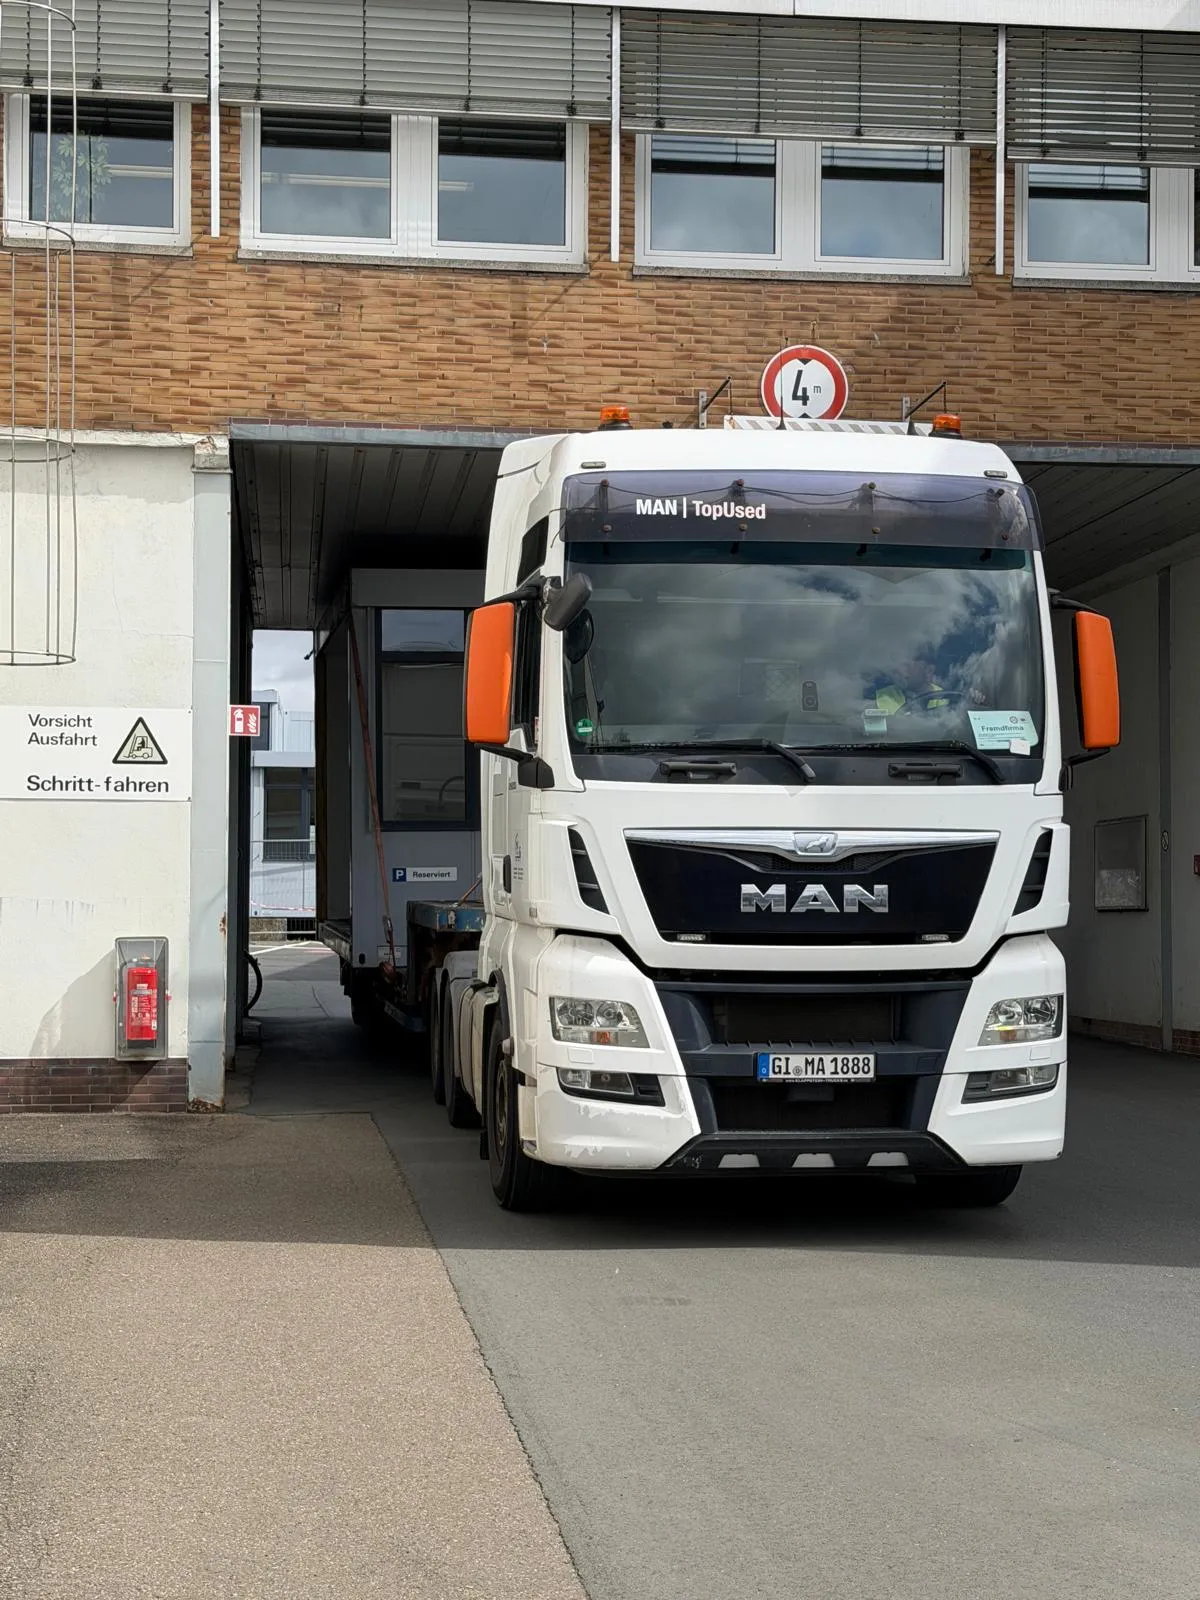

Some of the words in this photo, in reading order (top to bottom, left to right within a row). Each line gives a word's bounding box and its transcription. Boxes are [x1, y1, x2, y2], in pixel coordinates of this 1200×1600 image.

[792, 369, 809, 406] 4
[813, 385, 821, 394] m
[636, 499, 678, 516] MAN
[692, 501, 766, 520] TopUsed
[28, 714, 93, 728] Vorsicht
[28, 732, 98, 746] Ausfahrt
[396, 869, 404, 880] P
[741, 884, 888, 913] MAN
[772, 1057, 791, 1075] GI
[804, 1057, 825, 1075] MA
[830, 1057, 871, 1075] 1888
